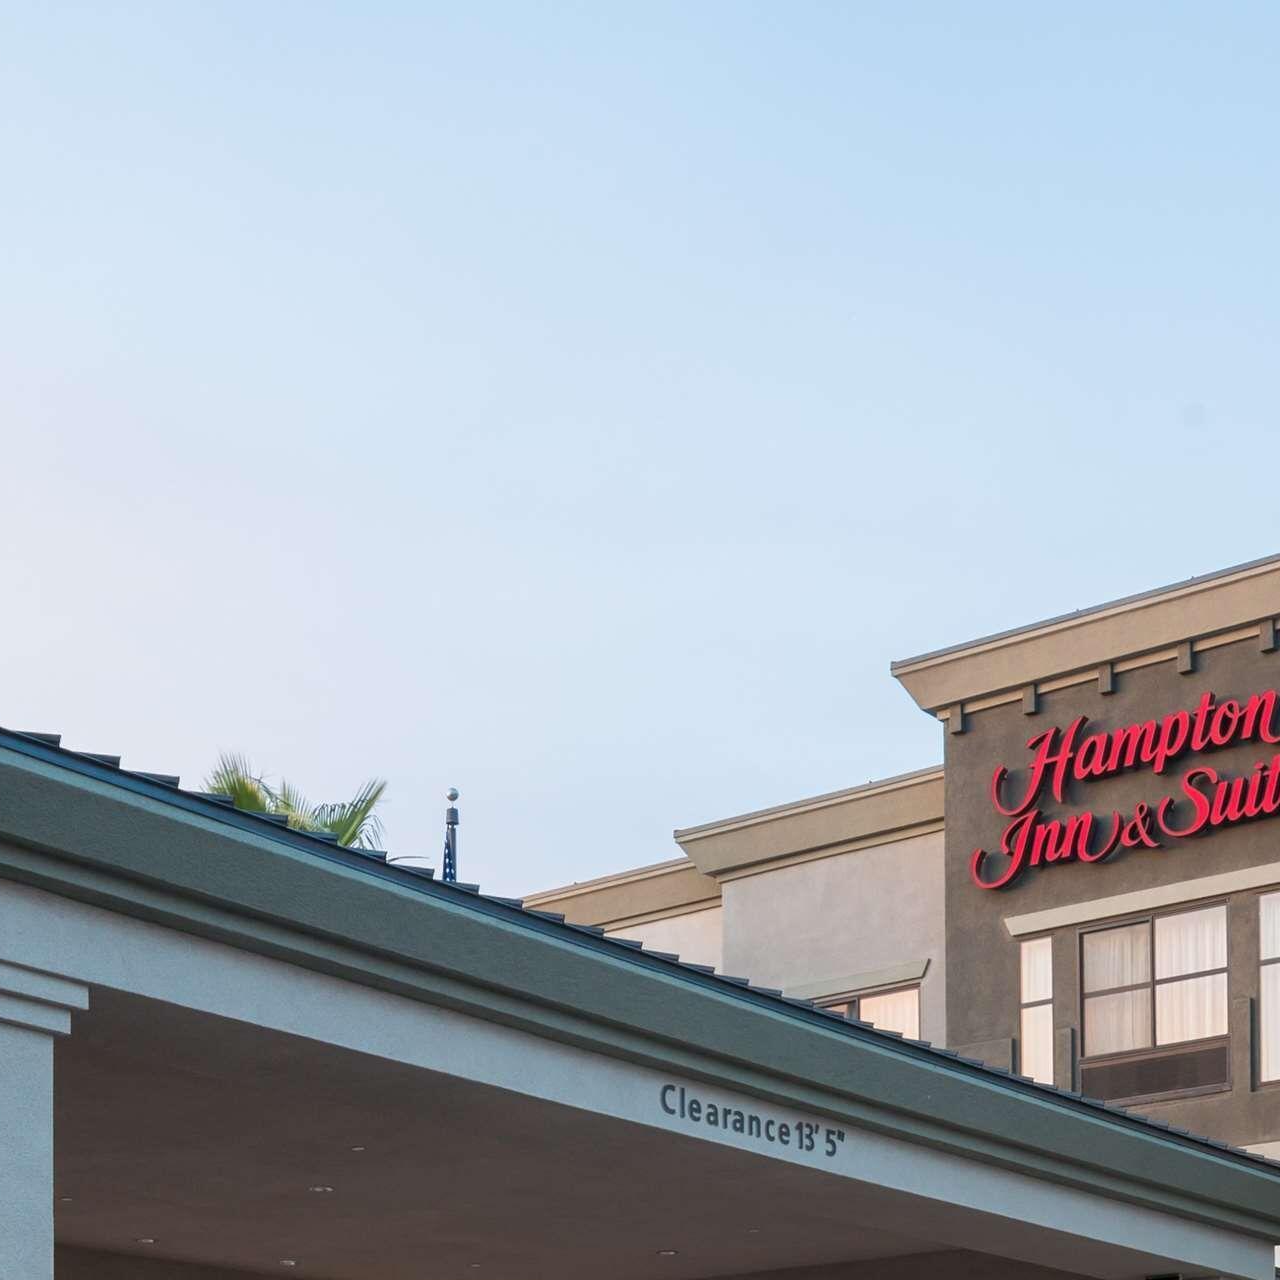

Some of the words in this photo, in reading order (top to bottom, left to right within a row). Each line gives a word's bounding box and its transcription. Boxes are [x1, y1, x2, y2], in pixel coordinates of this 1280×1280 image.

[970, 808, 1119, 890] Inn
[1121, 802, 1160, 848] &
[660, 1084, 790, 1145] Clearance
